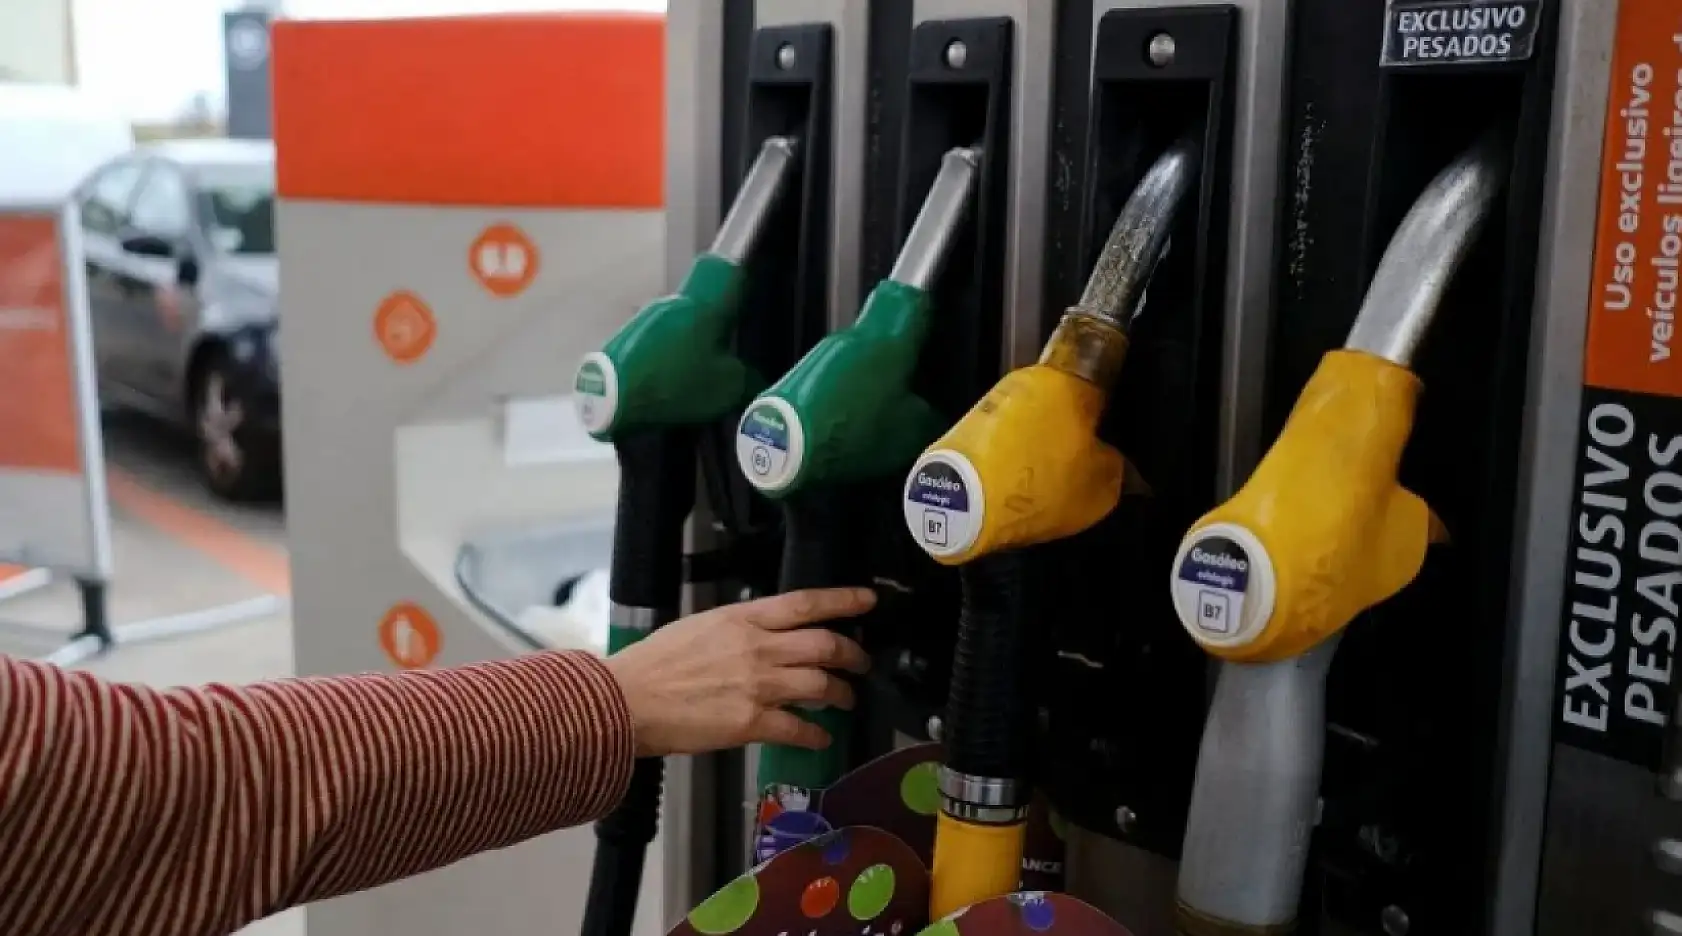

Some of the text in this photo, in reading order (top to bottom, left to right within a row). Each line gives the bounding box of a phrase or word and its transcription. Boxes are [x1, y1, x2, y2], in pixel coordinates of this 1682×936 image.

[1397, 5, 1526, 32] EXCLUSIVO
[1403, 33, 1512, 58] PESADOS
[1603, 62, 1654, 311] Uso exclusivo
[1645, 213, 1682, 363] veículos
[1203, 603, 1222, 621] B7
[1563, 403, 1635, 732] EXCLUSIVO
[1624, 432, 1682, 727] PESADOS
